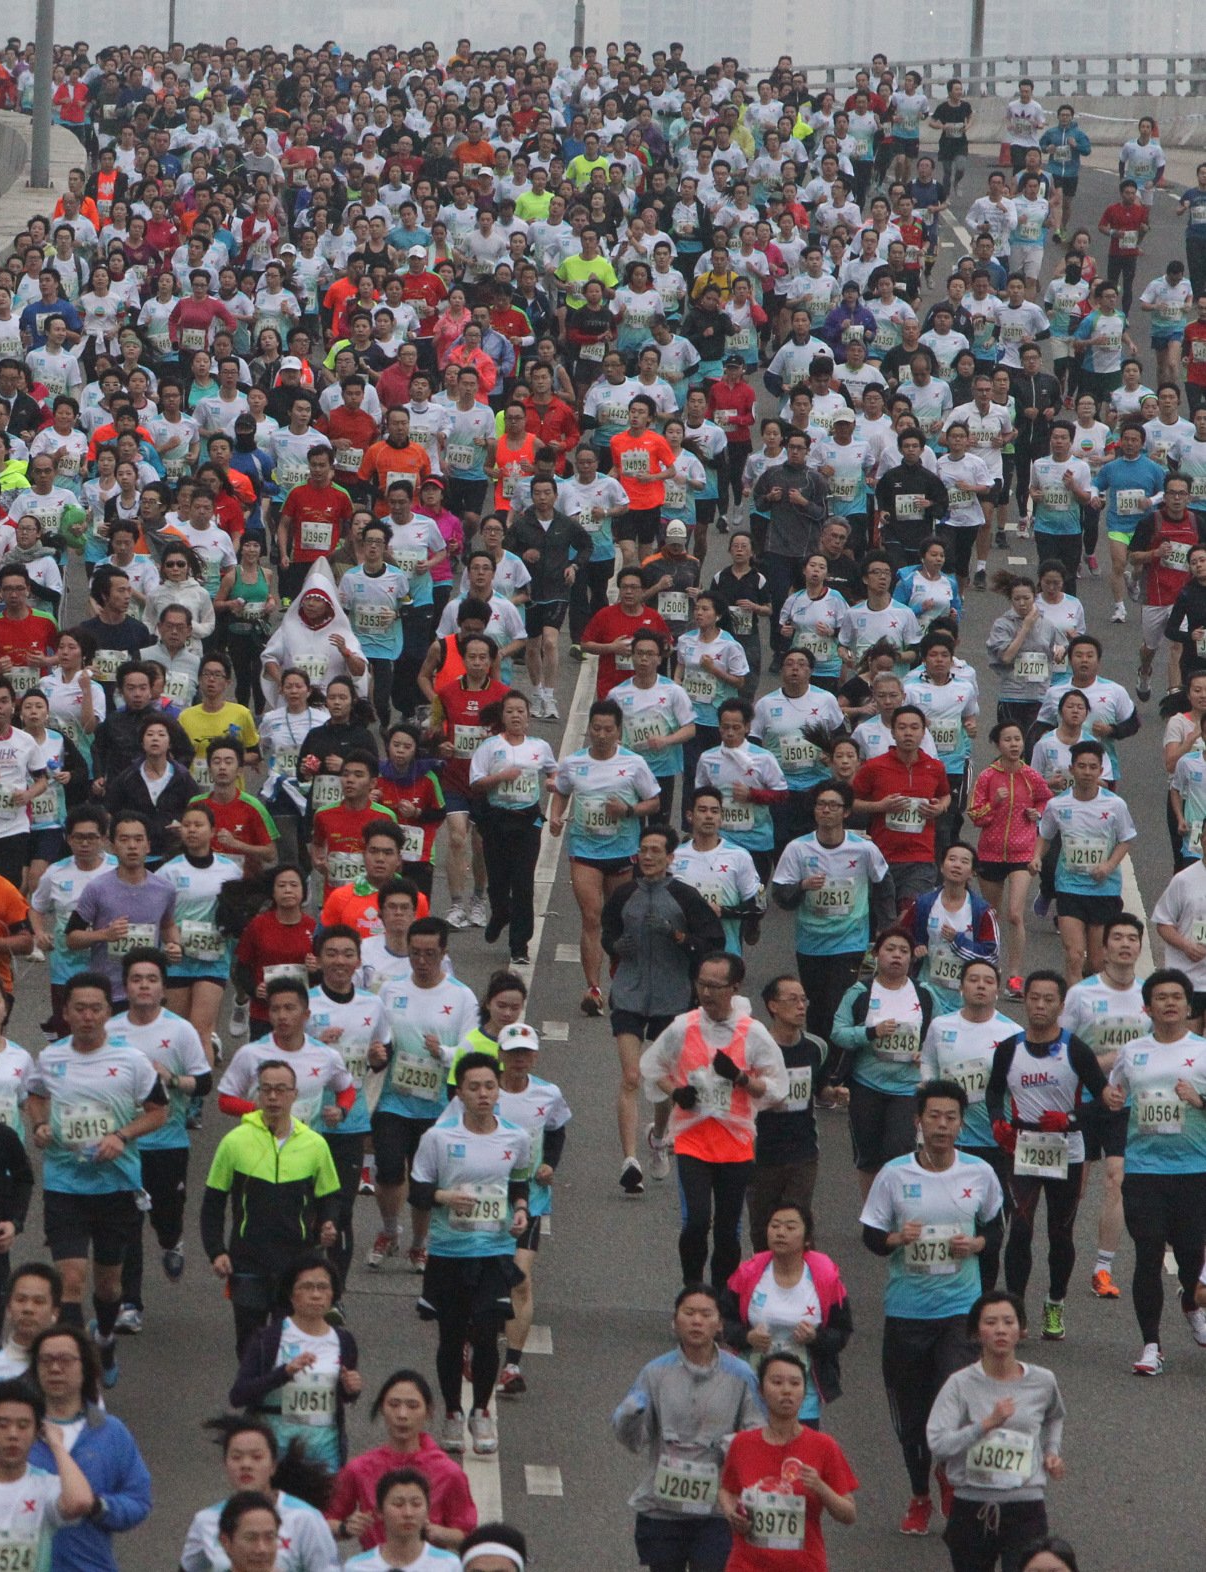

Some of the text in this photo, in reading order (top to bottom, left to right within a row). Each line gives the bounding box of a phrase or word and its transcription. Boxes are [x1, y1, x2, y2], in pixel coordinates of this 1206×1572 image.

[448, 453, 471, 464] K4376
[304, 532, 328, 544] J3967
[1018, 662, 1044, 677] J2707
[784, 745, 815, 760] J5015
[1070, 850, 1102, 865] J2167
[817, 890, 850, 906] J2512
[876, 1034, 915, 1051] J3348
[396, 1072, 438, 1089] J2330
[955, 1073, 985, 1090] 172
[1140, 1104, 1180, 1123] J0564
[66, 1121, 108, 1141] J6119
[1020, 1149, 1061, 1167] J2931
[974, 1449, 1024, 1471] J3027
[660, 1475, 711, 1500] J2057
